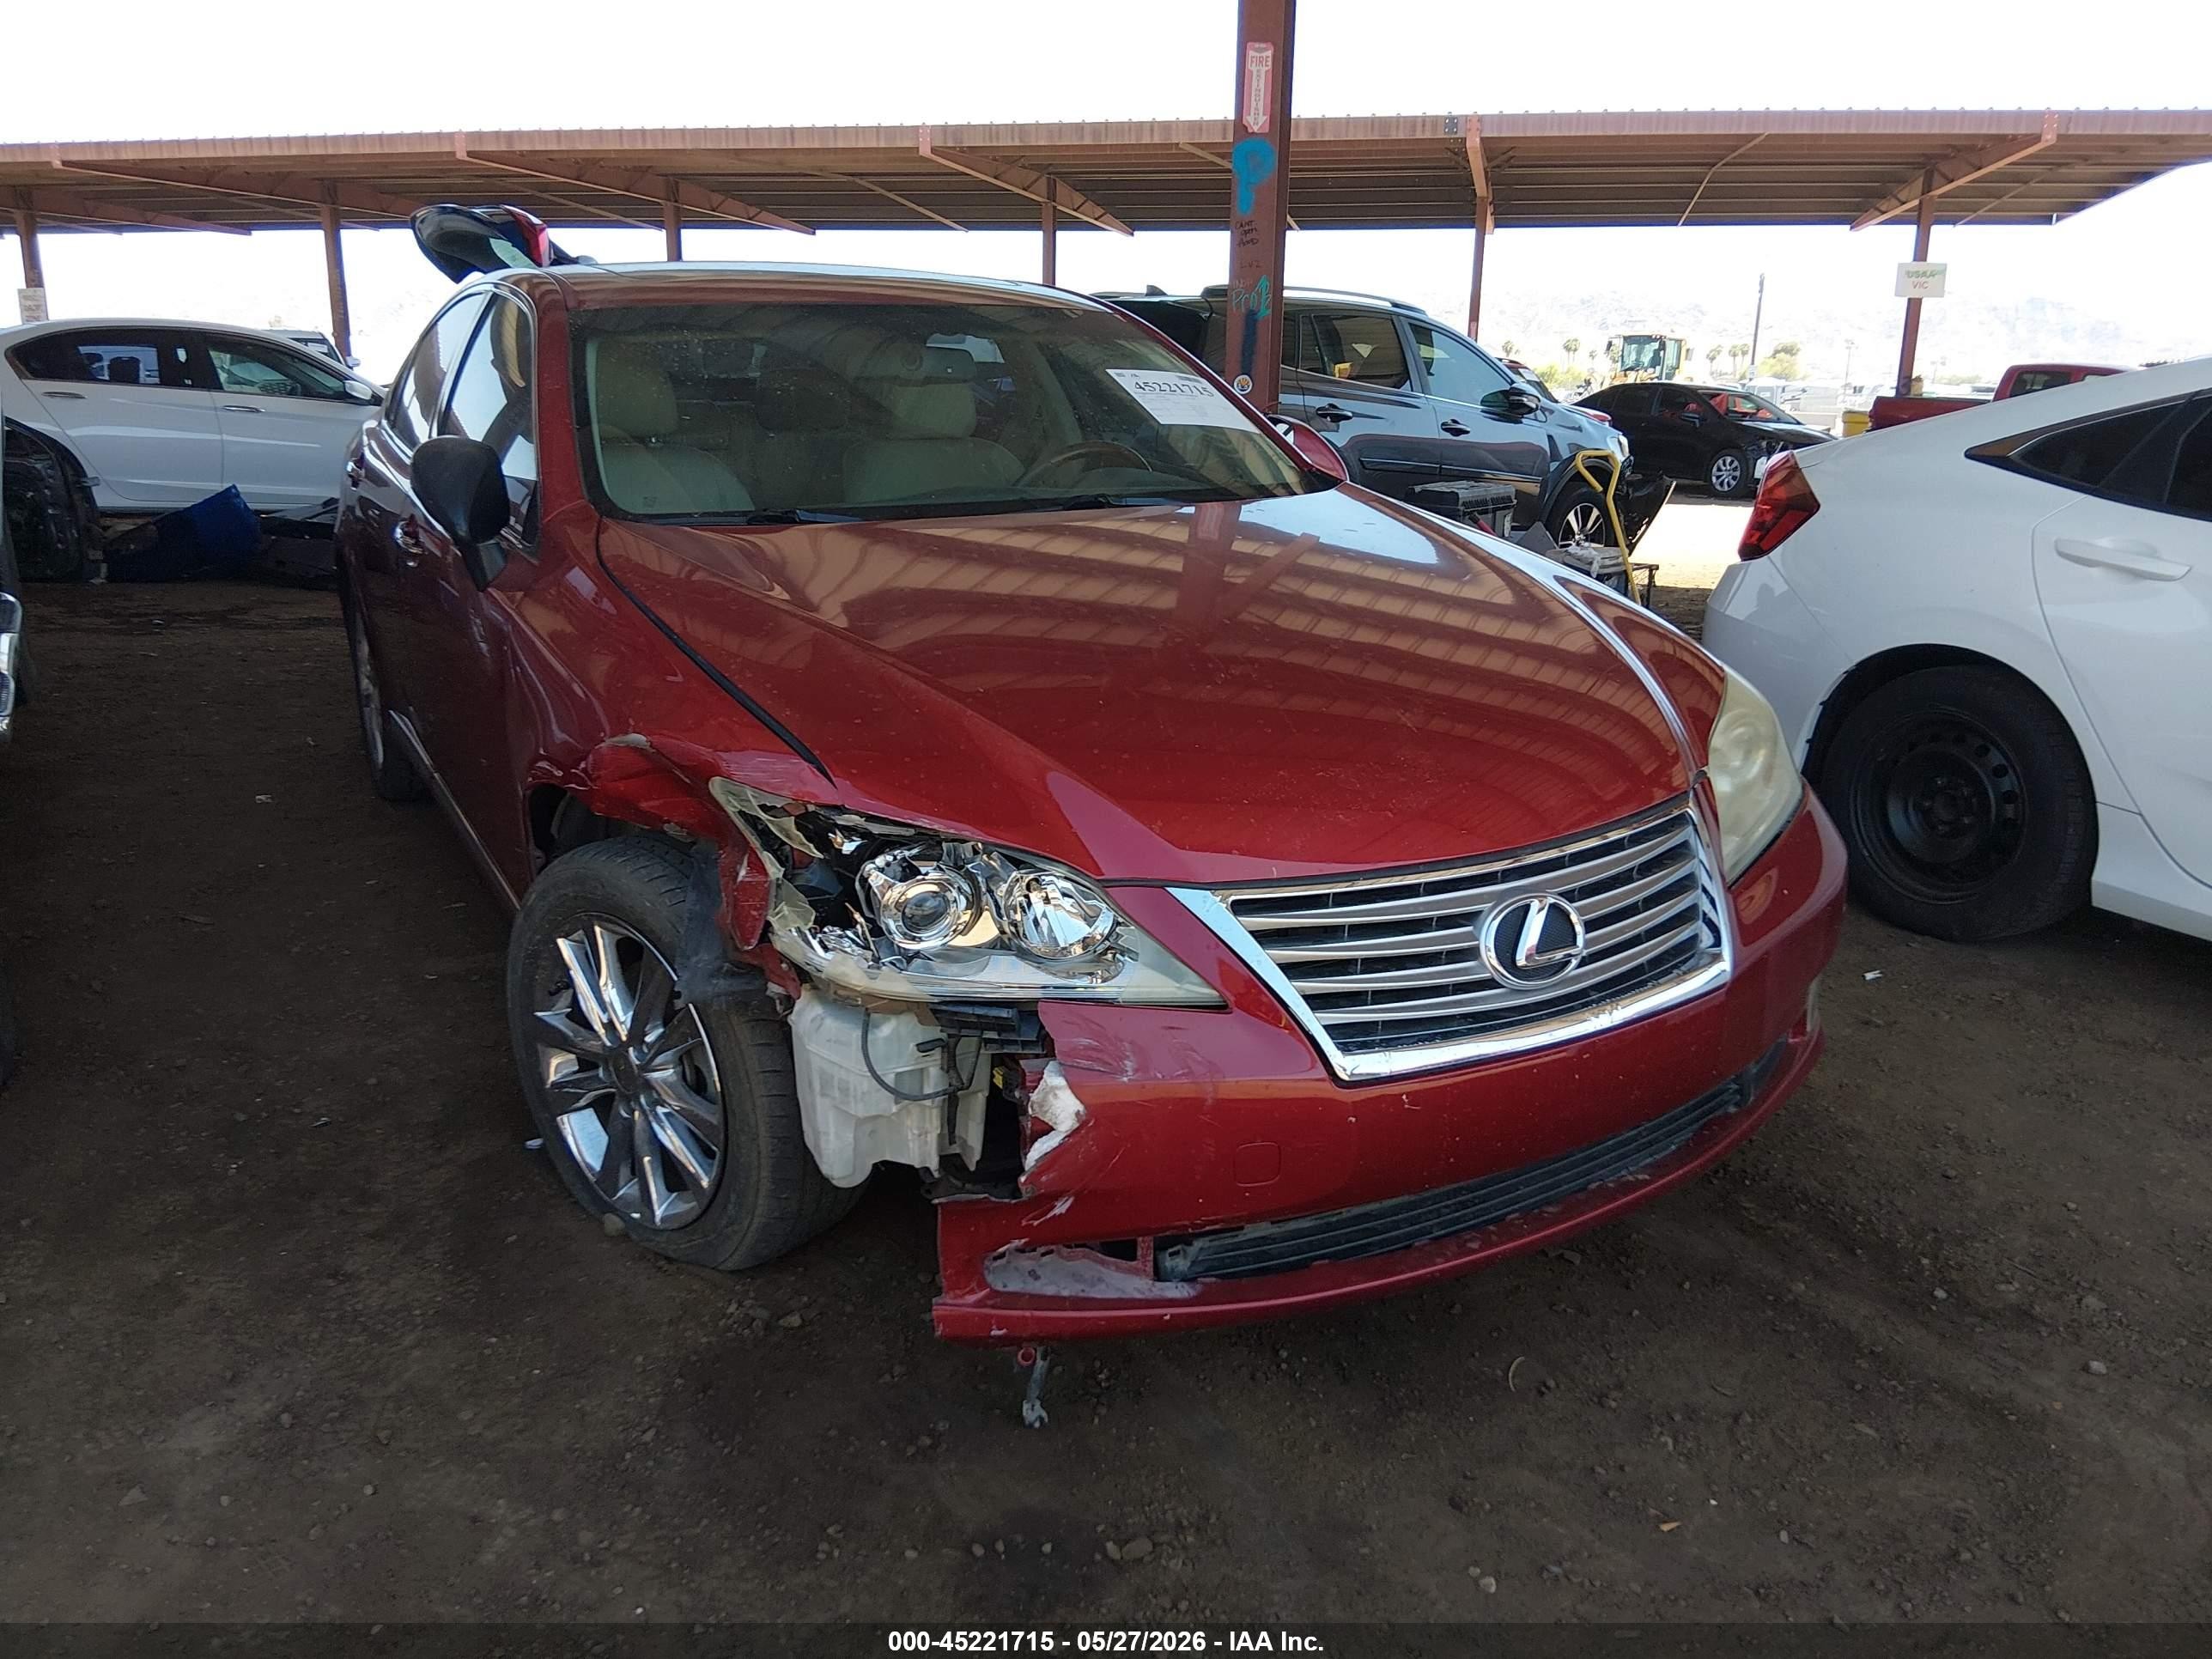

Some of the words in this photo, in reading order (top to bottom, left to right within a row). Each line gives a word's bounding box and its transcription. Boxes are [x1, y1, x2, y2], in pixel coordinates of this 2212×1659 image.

[1250, 55, 1270, 68] FIRE
[1911, 280, 1929, 289] VIC
[1134, 381, 1214, 398] 45221715
